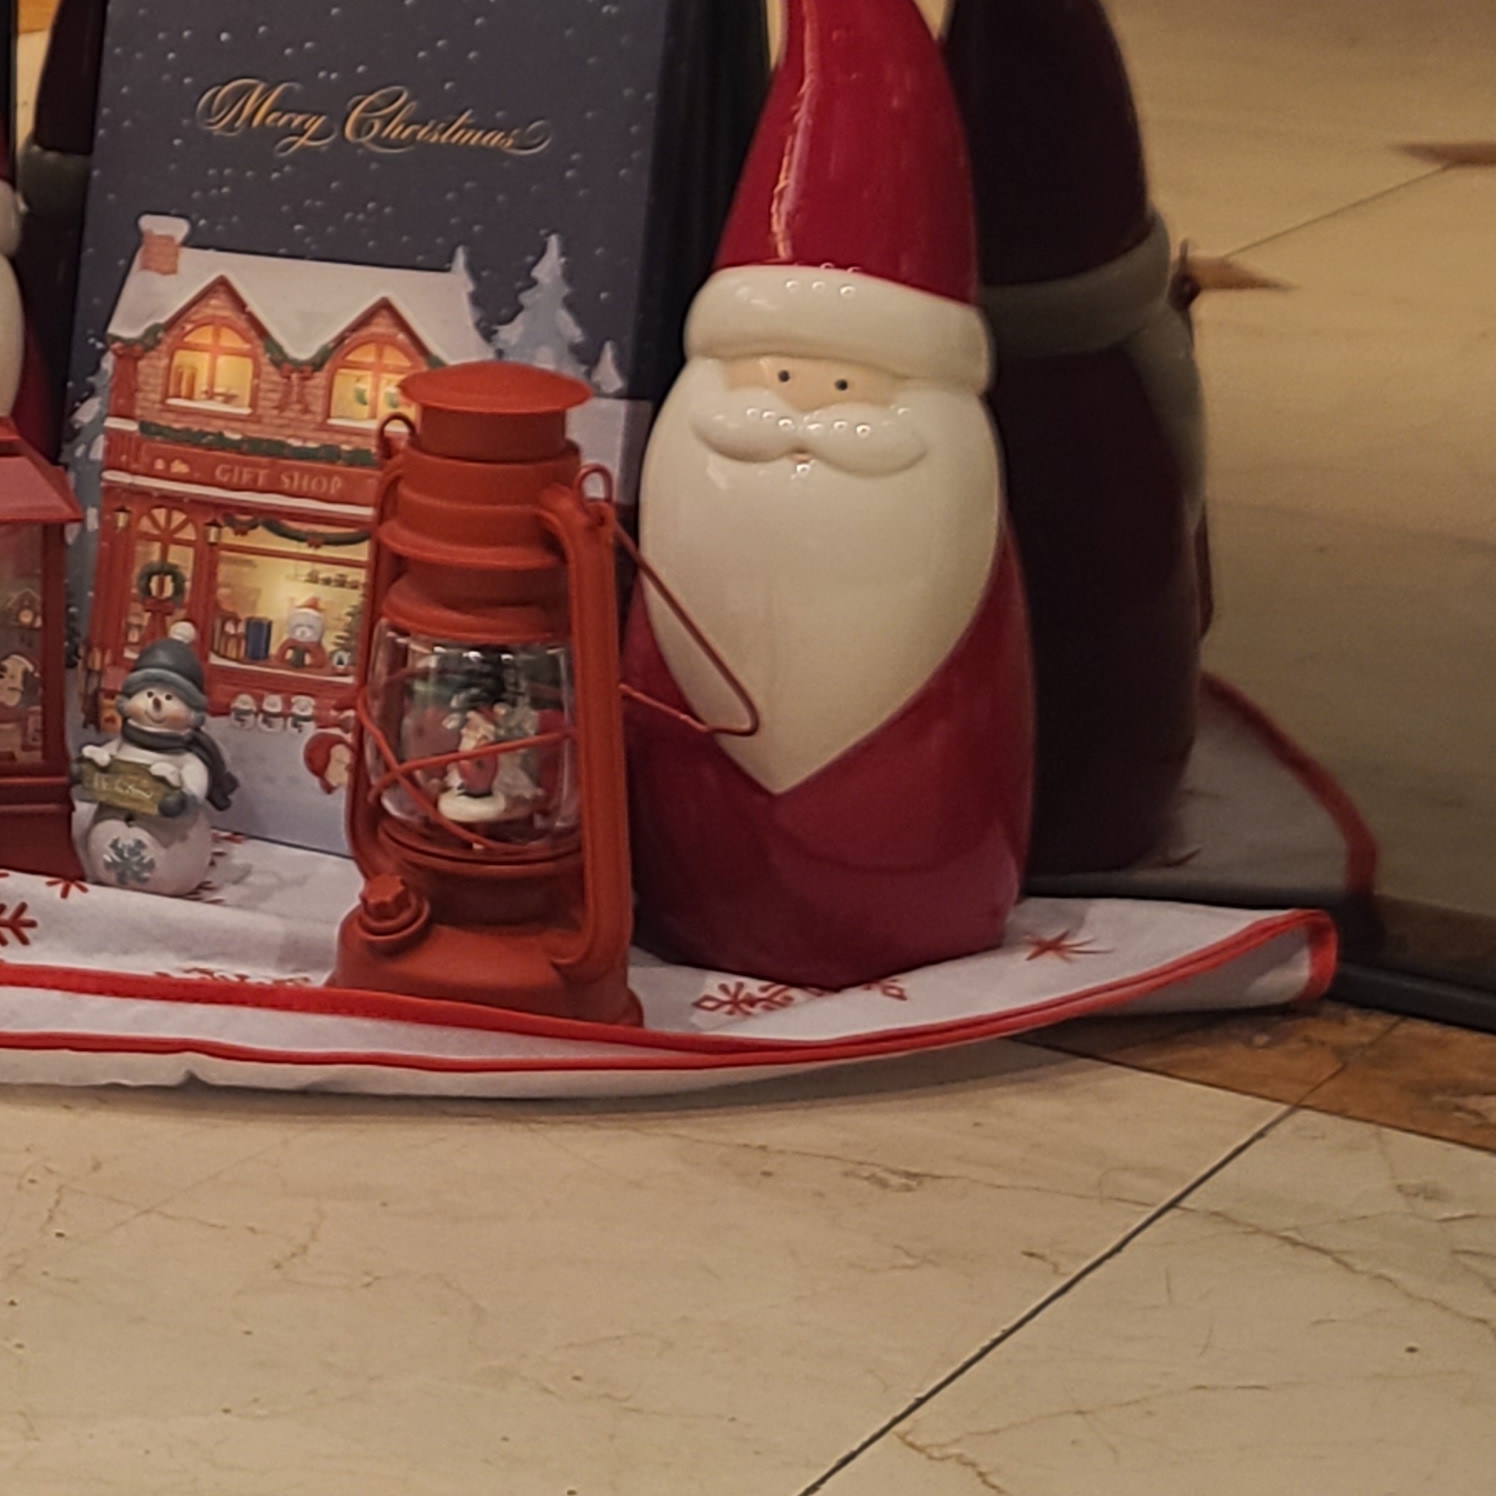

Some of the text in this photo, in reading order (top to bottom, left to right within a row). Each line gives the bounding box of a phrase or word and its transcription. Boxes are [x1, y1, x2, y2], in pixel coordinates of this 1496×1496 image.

[196, 77, 553, 158] Merry Christmas
[214, 462, 343, 495] GIFT SHOP
